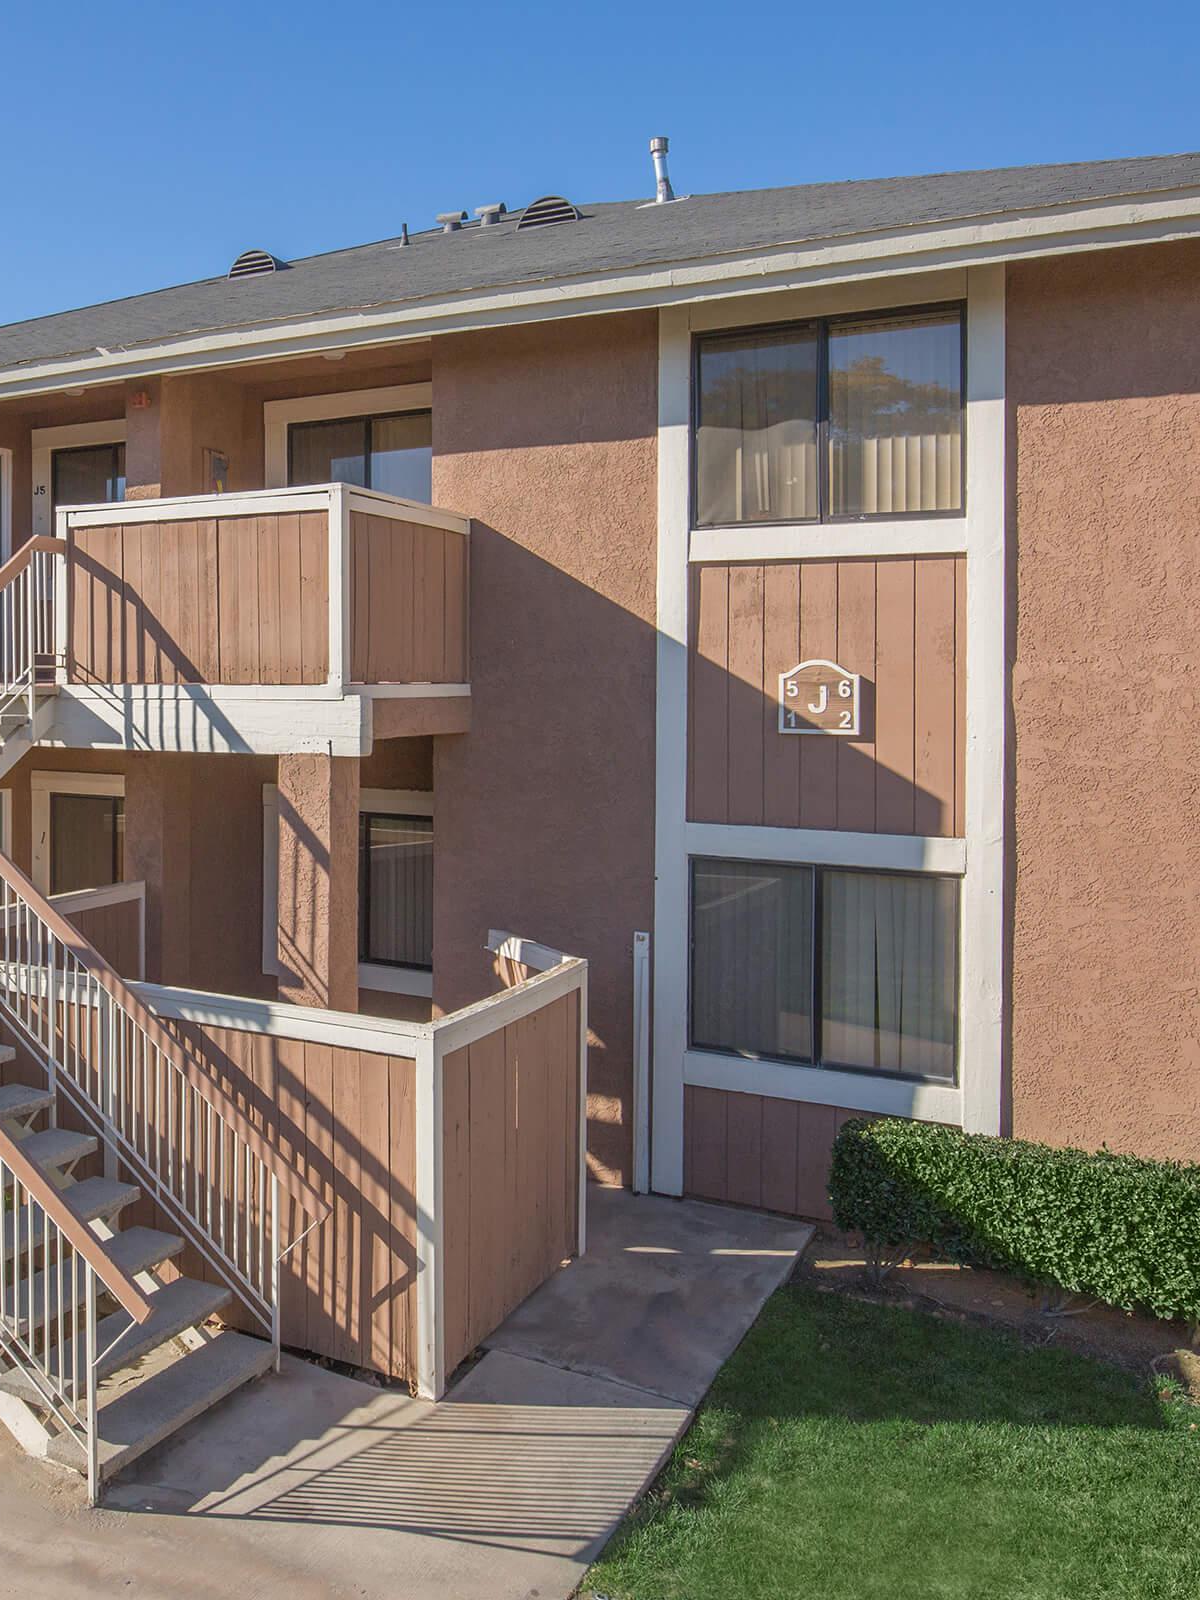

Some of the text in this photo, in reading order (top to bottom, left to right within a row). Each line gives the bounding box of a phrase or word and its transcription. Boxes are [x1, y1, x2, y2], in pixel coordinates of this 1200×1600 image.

[34, 485, 46, 496] J5
[786, 681, 798, 697] 5
[838, 680, 851, 698] 6
[807, 685, 828, 713] J
[786, 710, 796, 727] 1
[839, 711, 852, 728] 2
